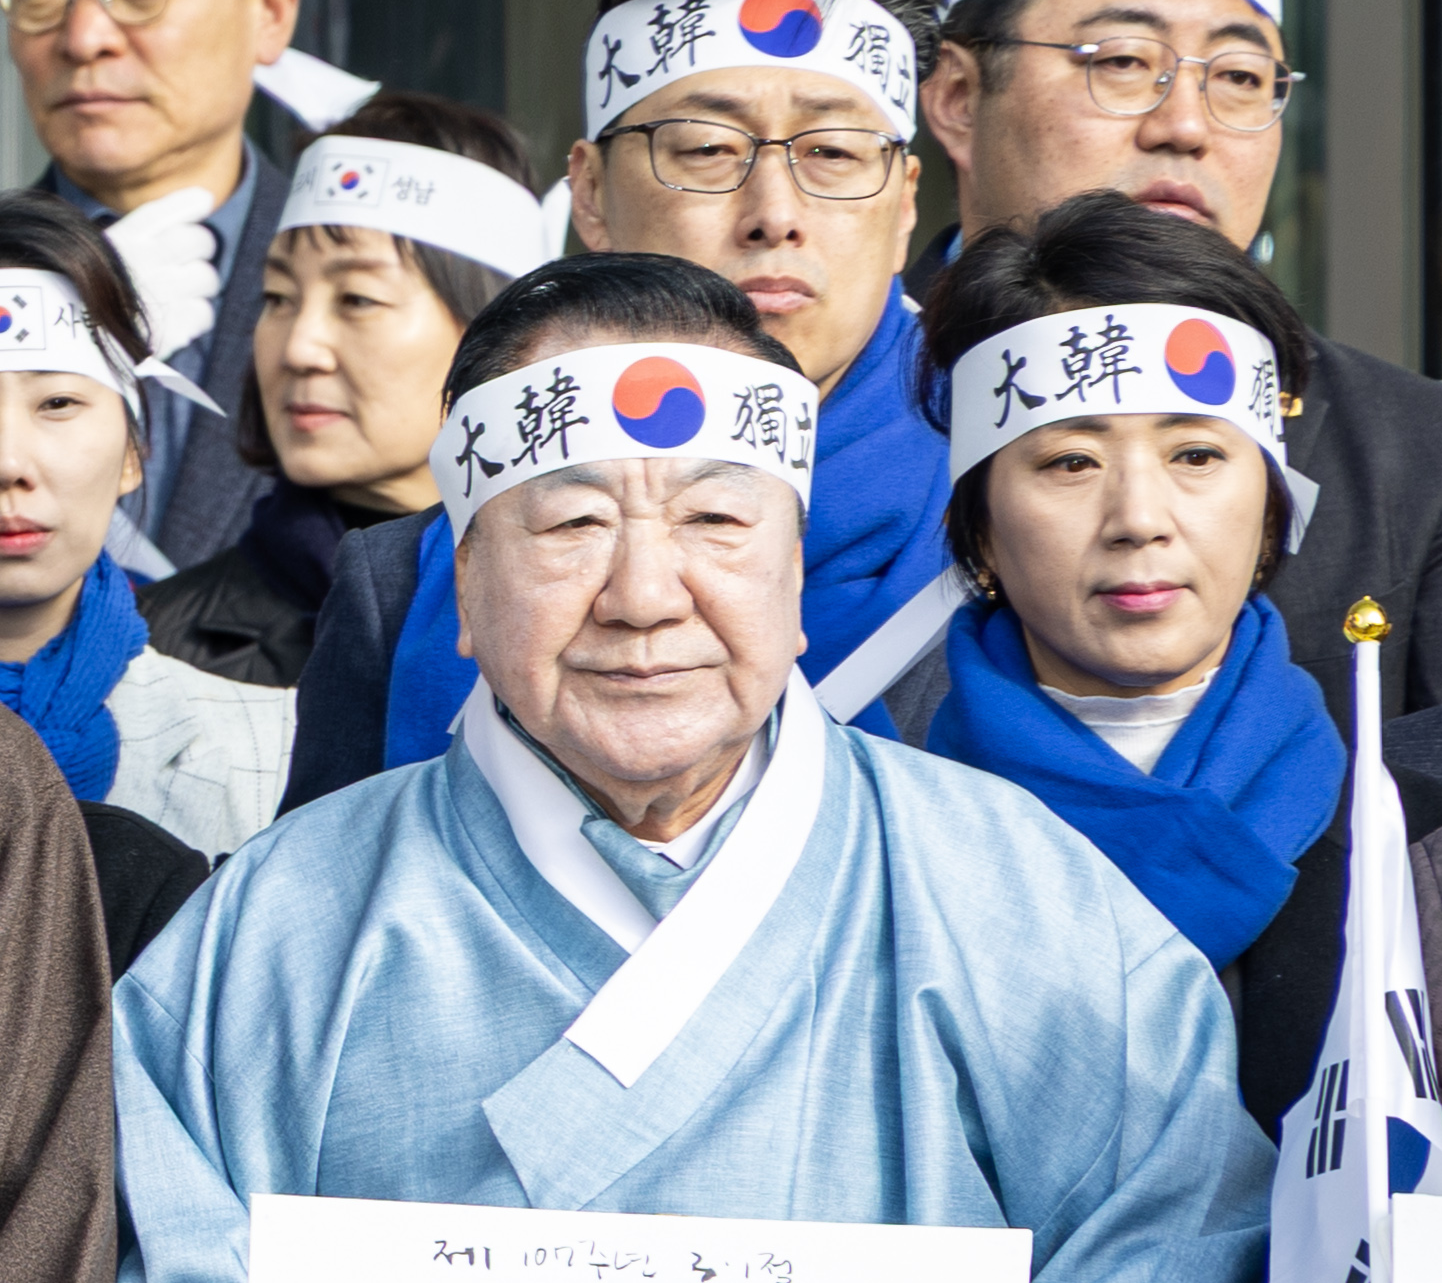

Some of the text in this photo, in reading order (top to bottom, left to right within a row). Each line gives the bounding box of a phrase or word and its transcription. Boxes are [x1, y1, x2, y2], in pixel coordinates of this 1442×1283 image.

[843, 20, 912, 112] 獨立
[391, 177, 436, 206] 성남
[993, 313, 1143, 429] 大韓
[454, 366, 591, 499] 大韓
